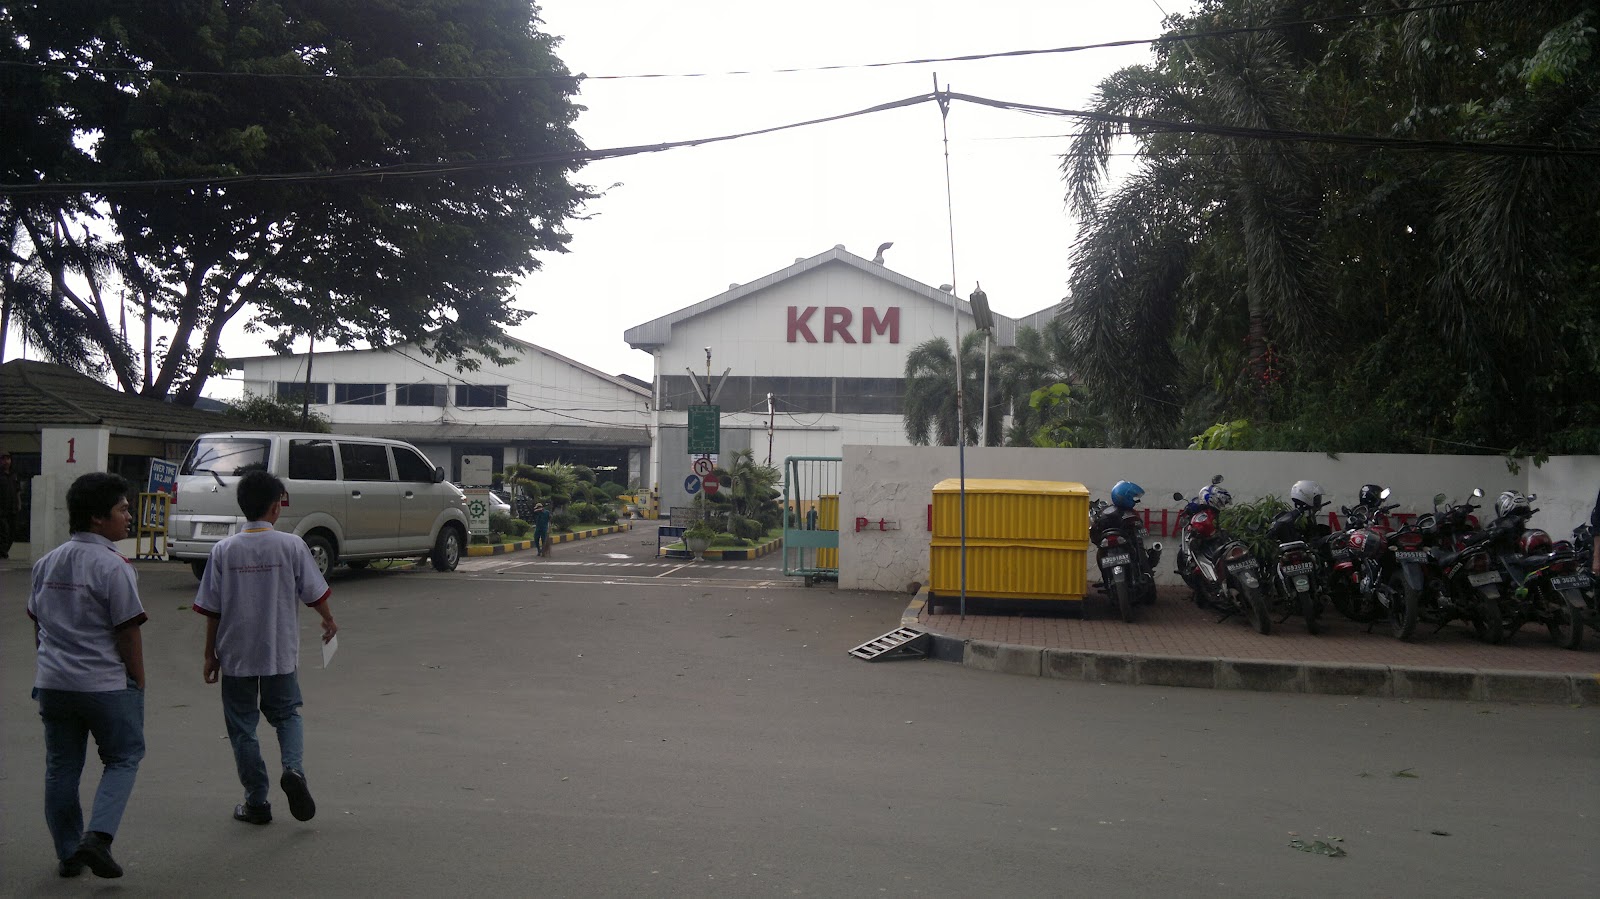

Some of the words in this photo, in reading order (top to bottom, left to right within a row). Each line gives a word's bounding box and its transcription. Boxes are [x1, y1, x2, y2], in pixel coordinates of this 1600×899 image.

[787, 306, 900, 344] KRM
[66, 438, 77, 463] 1
[152, 463, 165, 473] OVER
[165, 466, 176, 476] TIME
